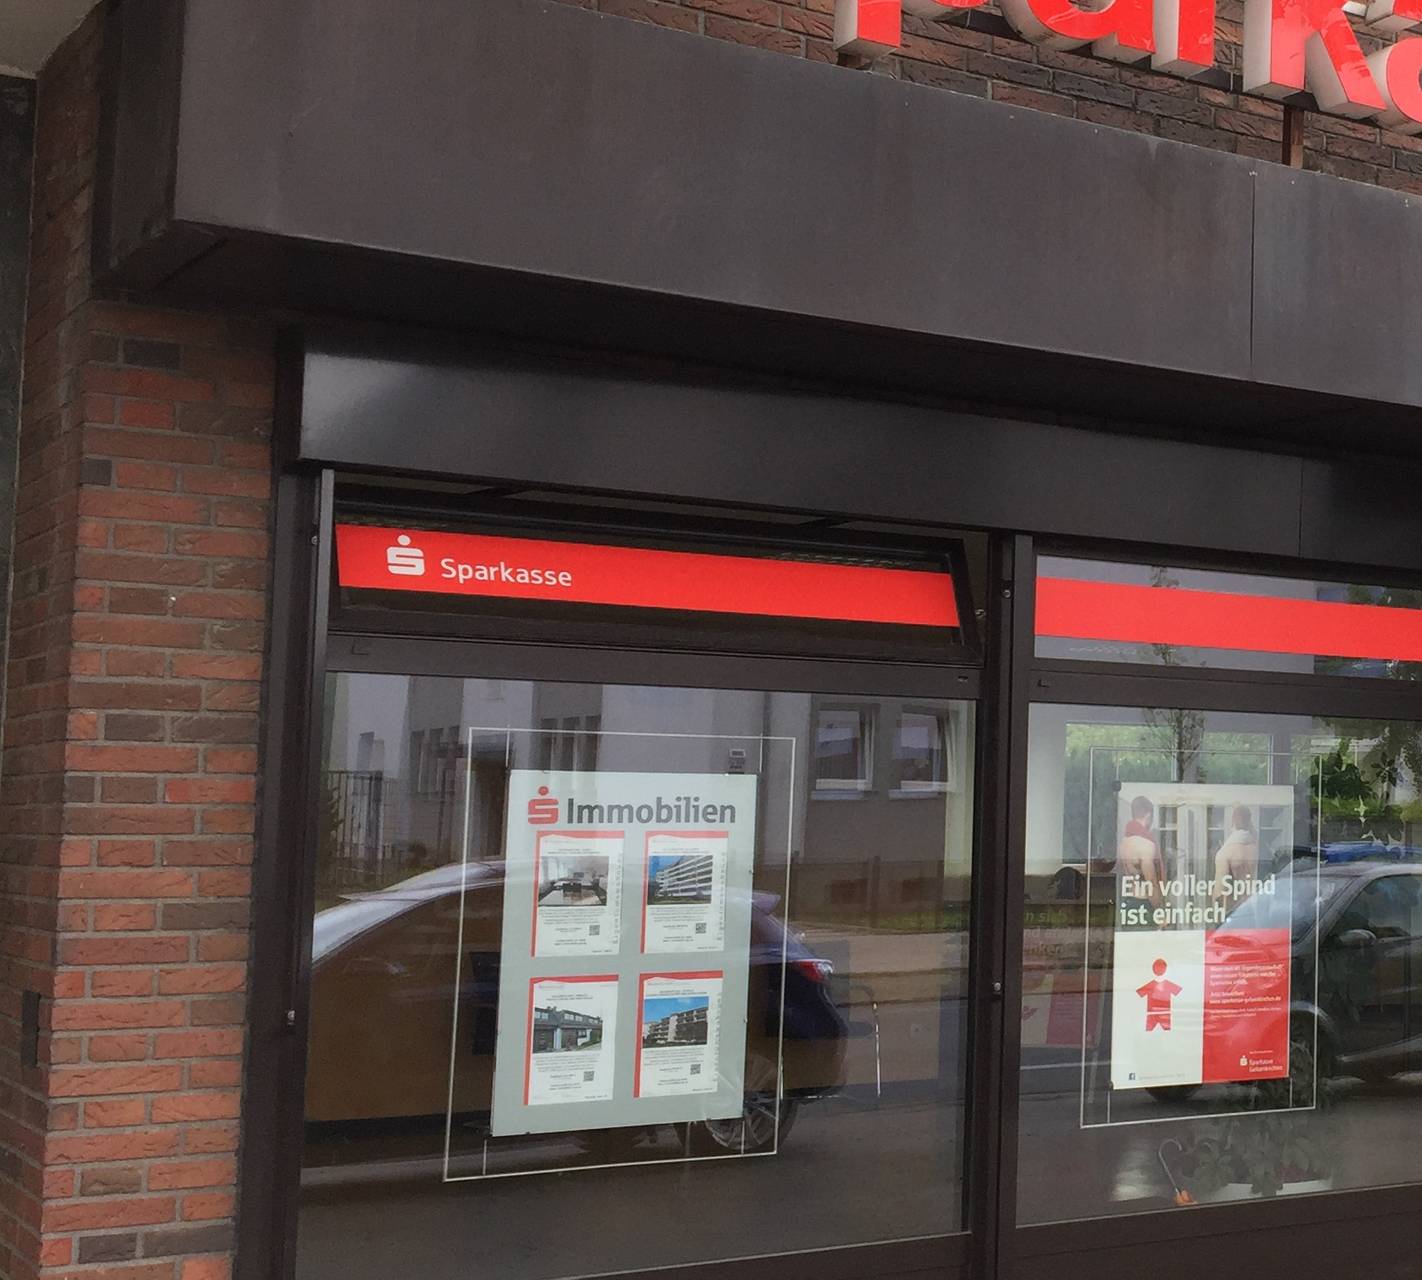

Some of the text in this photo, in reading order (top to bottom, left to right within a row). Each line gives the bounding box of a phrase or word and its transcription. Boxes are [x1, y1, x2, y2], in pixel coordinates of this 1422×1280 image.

[440, 558, 572, 587] Sparkasse
[567, 796, 736, 824] Immobilien
[1121, 874, 1276, 900] Ein voller Spind
[1119, 901, 1232, 926] ist einfach.
